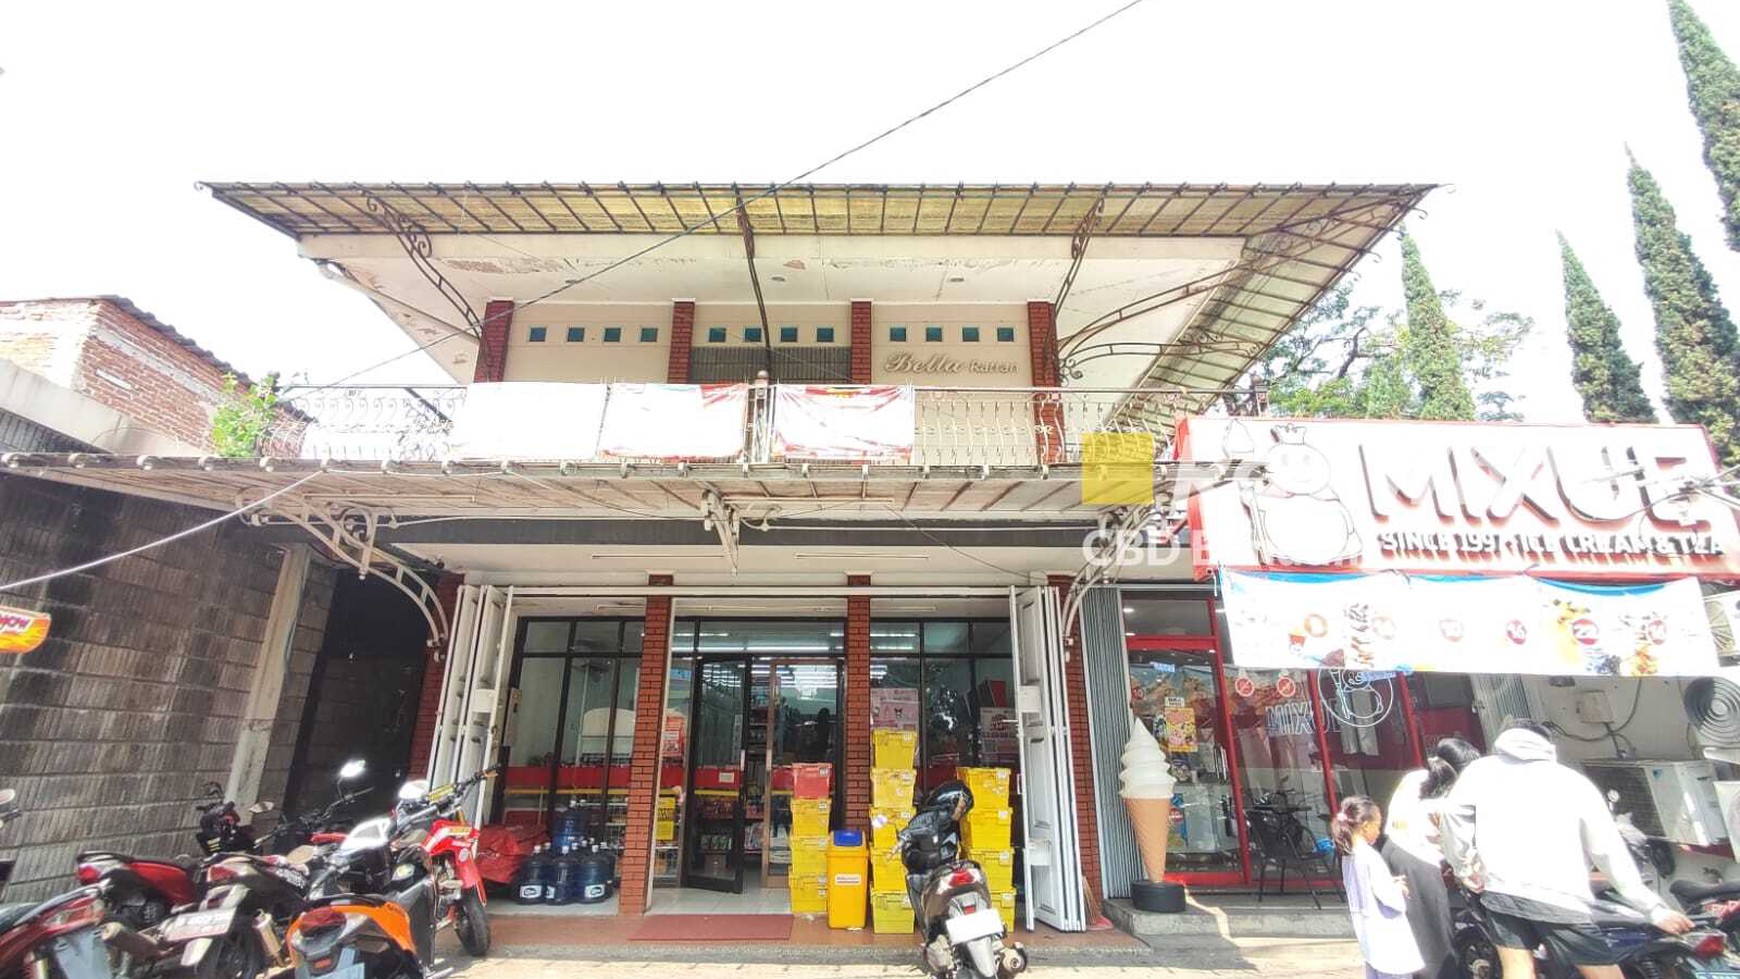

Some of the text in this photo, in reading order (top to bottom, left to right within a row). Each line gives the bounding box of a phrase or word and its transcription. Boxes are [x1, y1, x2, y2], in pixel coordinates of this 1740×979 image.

[884, 351, 1019, 375] Bella Rattan
[1357, 444, 1712, 528] MIXUE
[1377, 531, 1450, 556] SINCE
